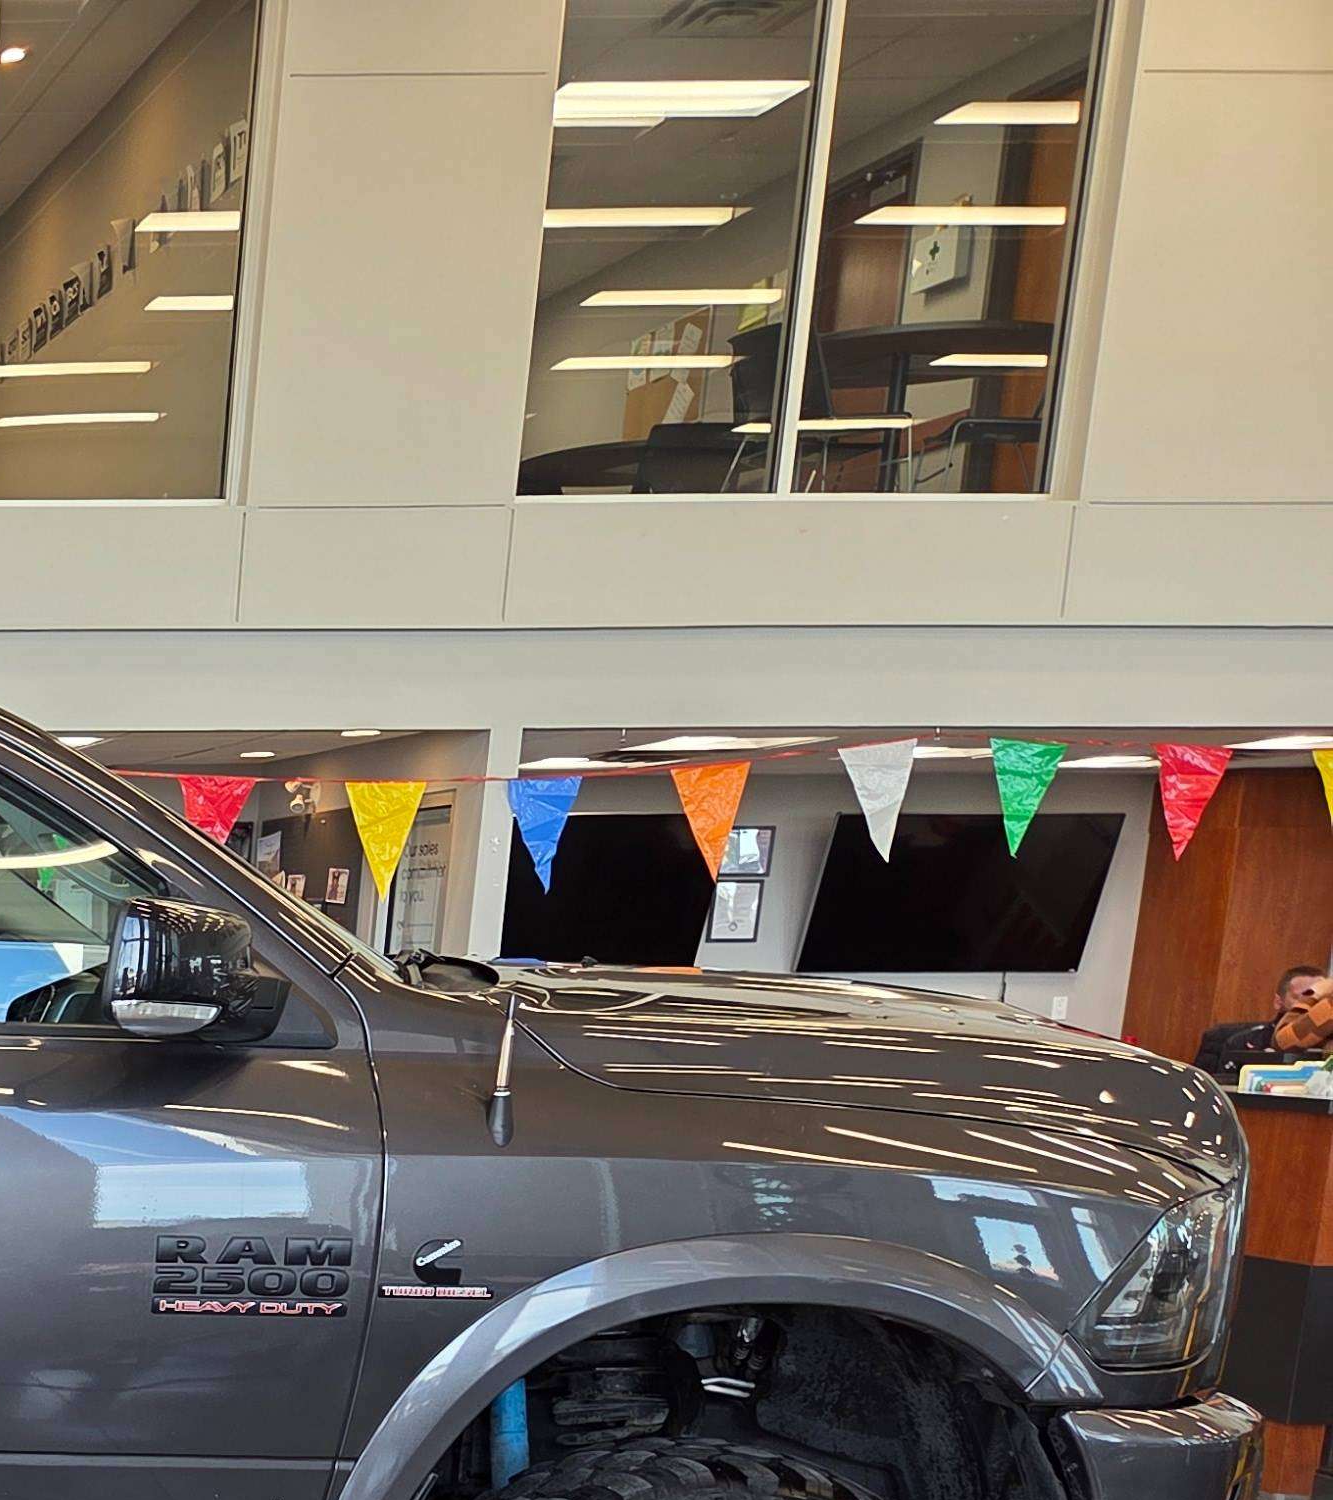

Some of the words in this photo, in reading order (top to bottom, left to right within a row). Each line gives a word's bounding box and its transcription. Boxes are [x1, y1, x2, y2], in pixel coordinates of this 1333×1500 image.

[155, 1235, 354, 1267] RAM
[153, 1266, 350, 1298] 2500
[159, 1299, 257, 1314] HEAVY
[259, 1301, 343, 1315] DUTY
